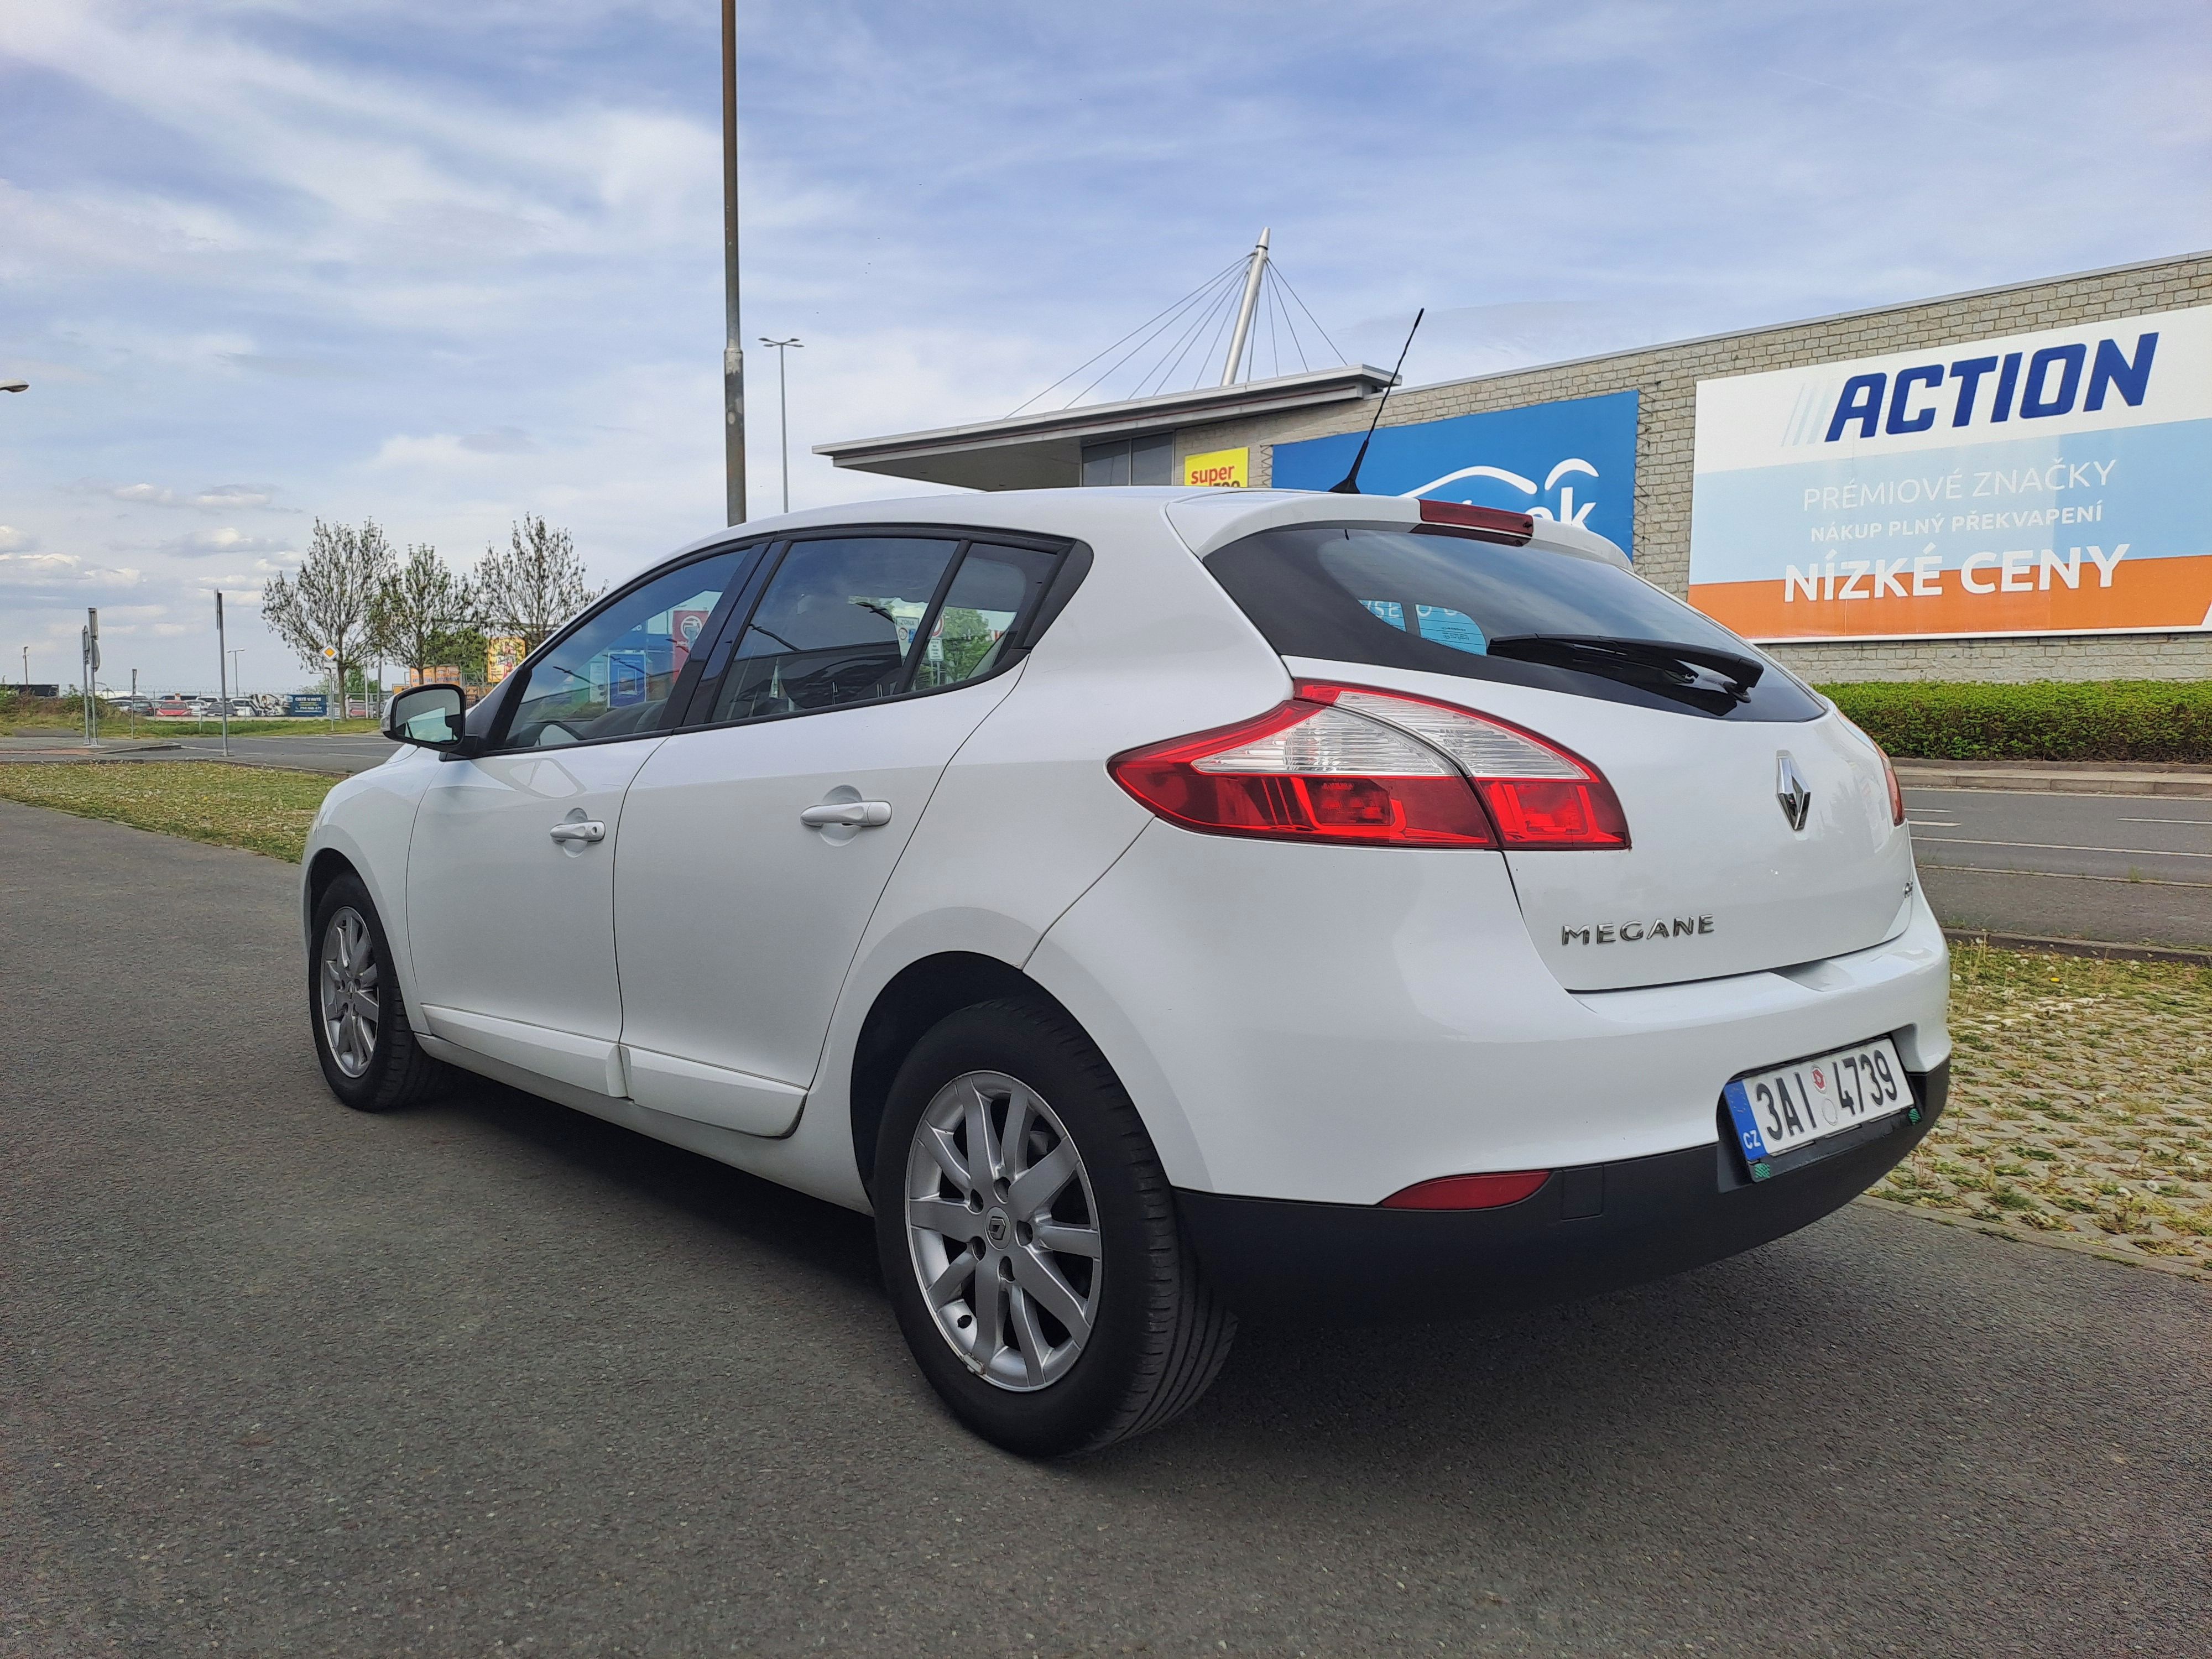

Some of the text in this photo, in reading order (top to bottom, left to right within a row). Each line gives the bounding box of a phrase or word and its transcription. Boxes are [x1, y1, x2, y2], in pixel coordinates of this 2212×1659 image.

[1826, 332, 2159, 442] ACTION
[1191, 466, 1235, 487] super
[1803, 457, 2116, 512] PRÉMIOVÉ ZNAČKY
[1811, 499, 2103, 542] NÁKUP PLNÝ PŘEKVAPENÍ
[1784, 542, 2130, 603] NÍZKÉ CENY
[1562, 914, 1715, 946] MEGANE
[1756, 1049, 1897, 1141] 3AI 4739
[1743, 1130, 1762, 1150] CZ
